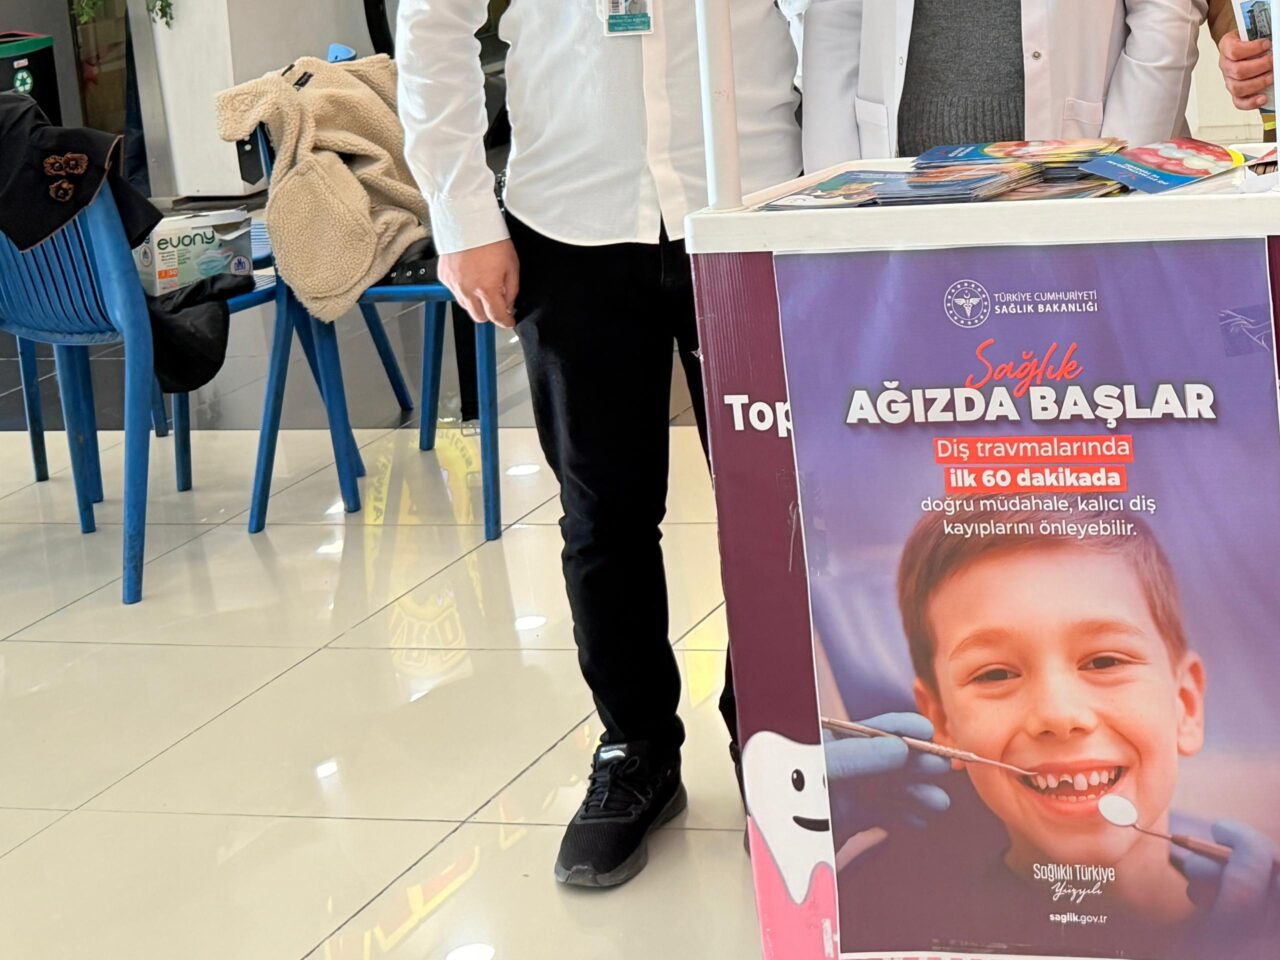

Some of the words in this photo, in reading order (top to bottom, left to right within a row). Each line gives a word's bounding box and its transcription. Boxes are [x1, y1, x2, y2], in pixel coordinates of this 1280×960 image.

[993, 290, 1033, 302] TÜRKİYE
[1034, 289, 1097, 302] CUMHURİYETİ
[994, 303, 1034, 314] SAĞLIK
[1038, 301, 1098, 313] BAKANLIĞI
[965, 338, 1084, 399] Sağlık
[846, 380, 1021, 425] AĞIZDA
[1029, 382, 1217, 429] BAŞLAR
[723, 394, 792, 438] Top
[937, 439, 970, 461] Diş
[976, 436, 1130, 457] travmalarında
[950, 467, 977, 488] ilk
[982, 469, 1011, 488] 60
[1016, 466, 1121, 487] dakikada
[921, 497, 974, 515] doğru
[980, 495, 1073, 514] müdahale,
[1078, 495, 1124, 512] kalıcı
[1129, 495, 1156, 515] diş
[943, 519, 1034, 538] kayıplarını
[1039, 518, 1138, 540] önleyebilir.
[1032, 863, 1073, 882] Sağlıklı
[1074, 864, 1116, 883] Türkiye
[1051, 881, 1103, 904] Yüzyılı
[1049, 912, 1108, 925] saglik.gov.tr
